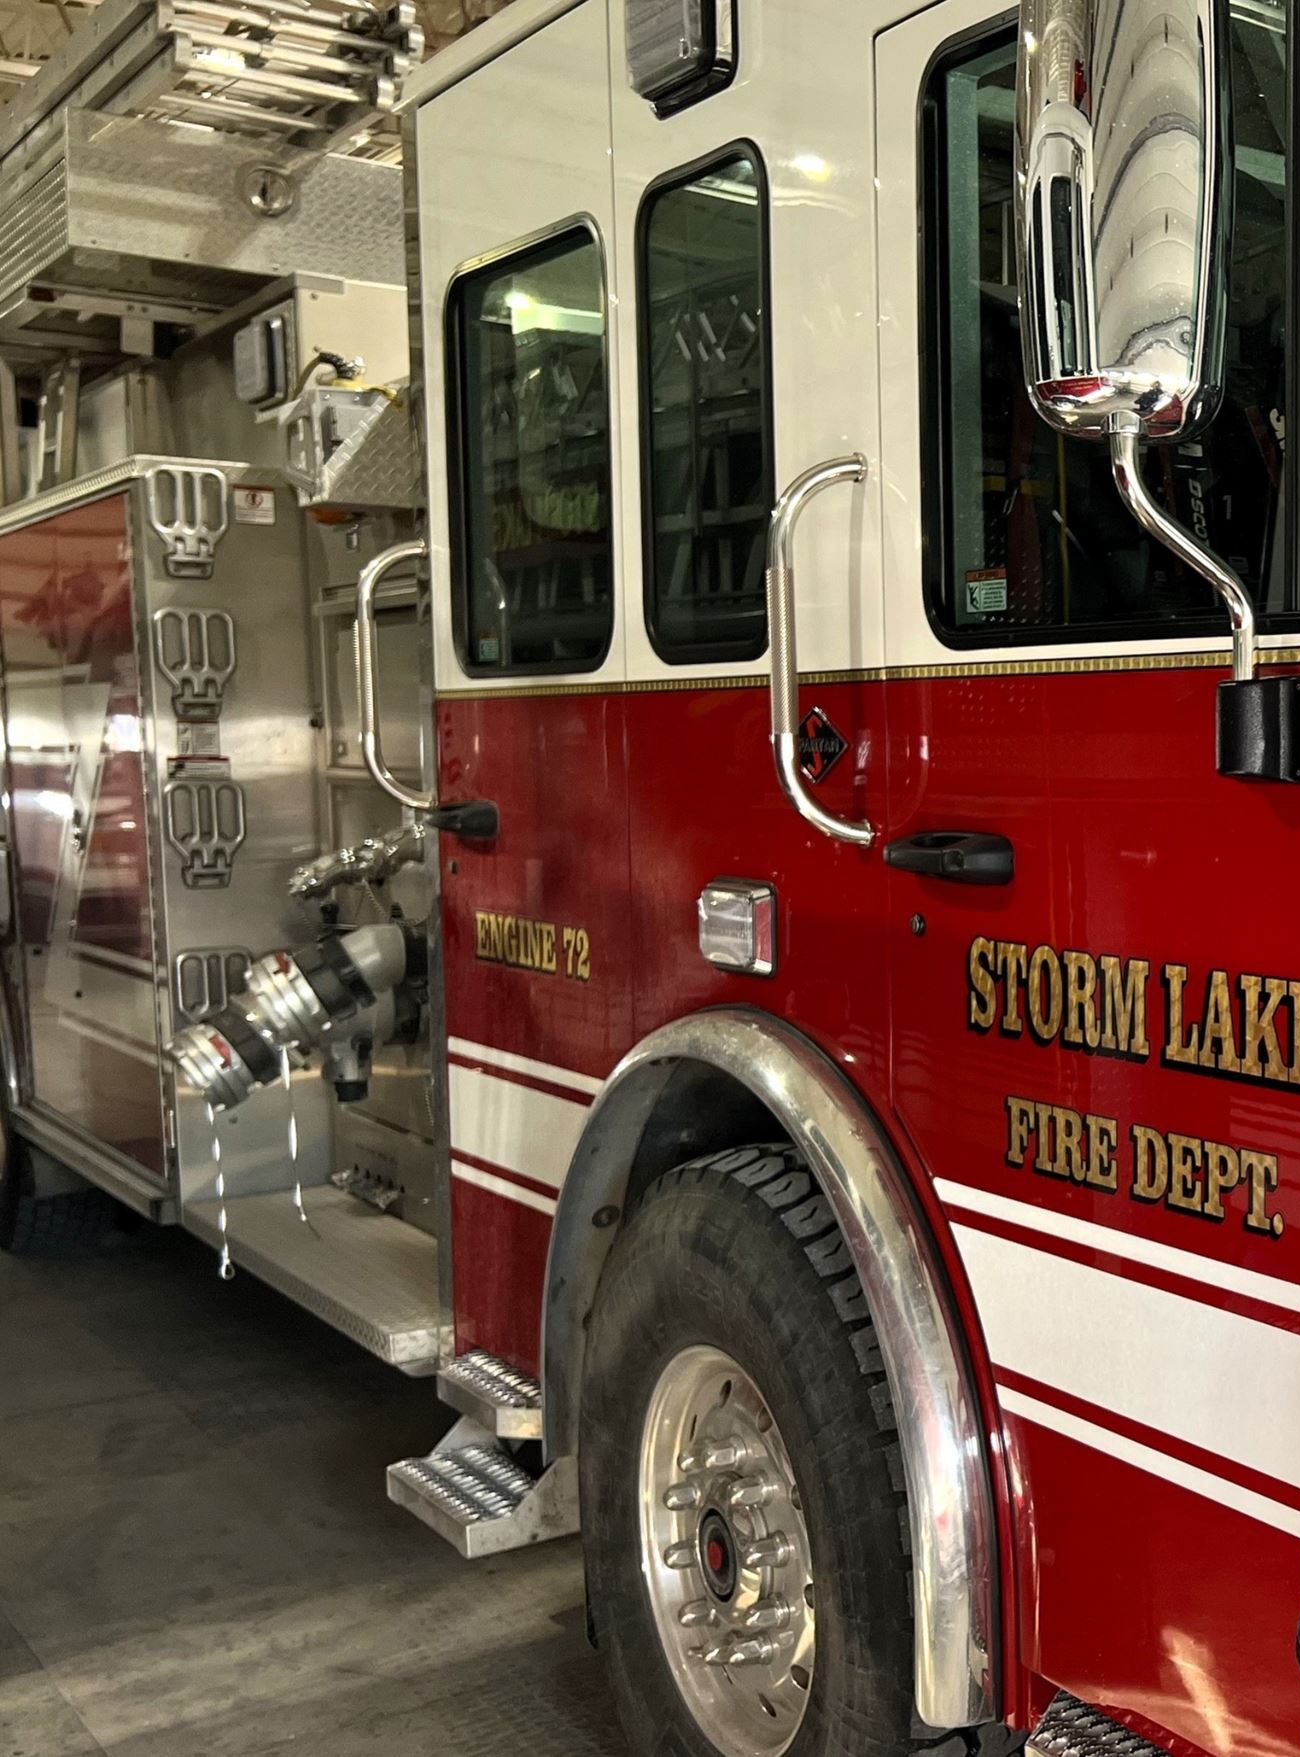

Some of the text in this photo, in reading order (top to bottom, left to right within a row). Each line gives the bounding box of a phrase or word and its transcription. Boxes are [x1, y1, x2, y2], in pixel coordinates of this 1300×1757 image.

[799, 738, 840, 752] PARTAN
[475, 909, 591, 981] ENGINE 72
[968, 935, 1150, 1061] STORM
[1006, 1094, 1286, 1237] FIRE DEPT.
